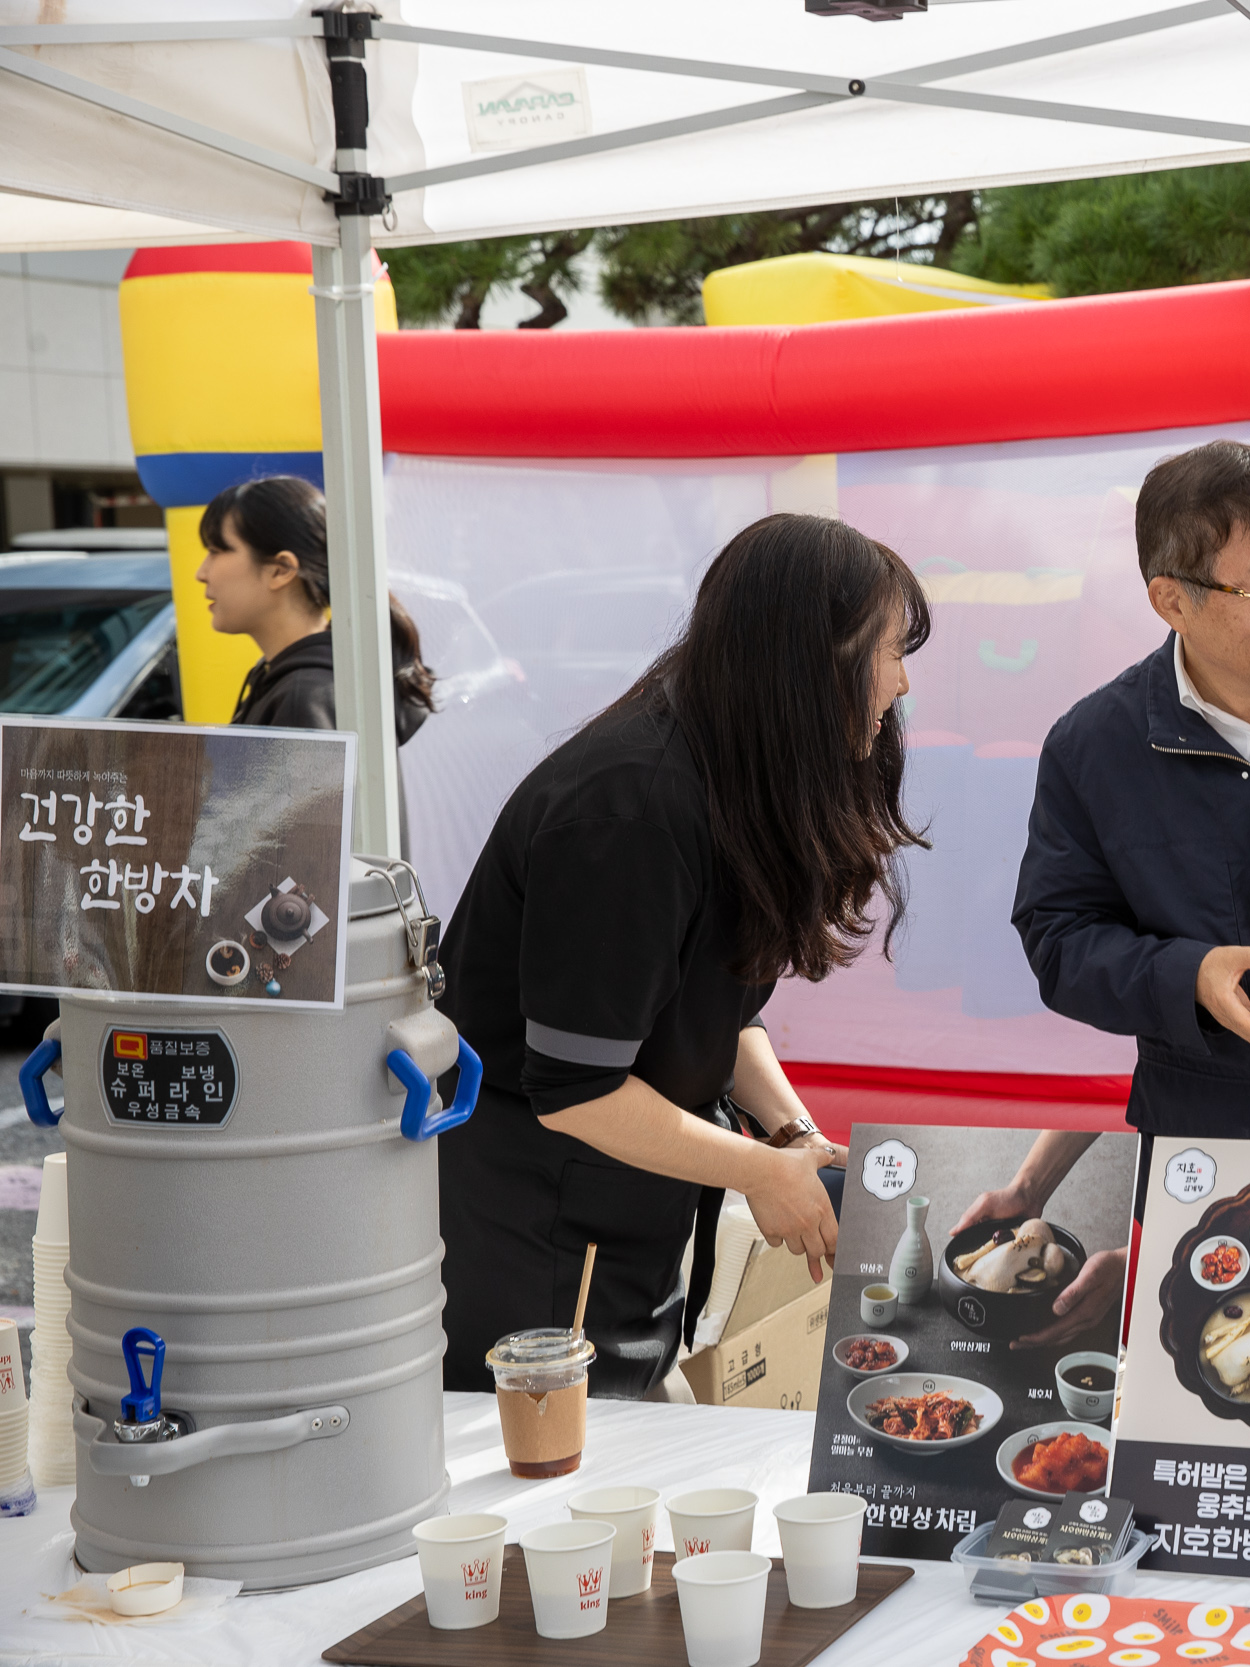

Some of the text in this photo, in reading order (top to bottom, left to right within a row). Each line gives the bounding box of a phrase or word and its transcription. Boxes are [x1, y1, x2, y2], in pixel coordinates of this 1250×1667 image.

[20, 768, 54, 780] 마음까지
[56, 770, 91, 781] 따뜻하게
[19, 790, 151, 845] 건강한
[79, 858, 219, 917] 한방차
[150, 1040, 211, 1056] 품질보증
[117, 1061, 215, 1081] 보온 보냉
[127, 1101, 201, 1120] 우성금속
[874, 1154, 896, 1167] 지호
[1176, 1162, 1197, 1174] 지호
[1153, 1458, 1248, 1491] 특허받은
[830, 1481, 916, 1500] 처음부터 끝까지
[465, 1589, 488, 1601] king
[580, 1598, 601, 1611] king
